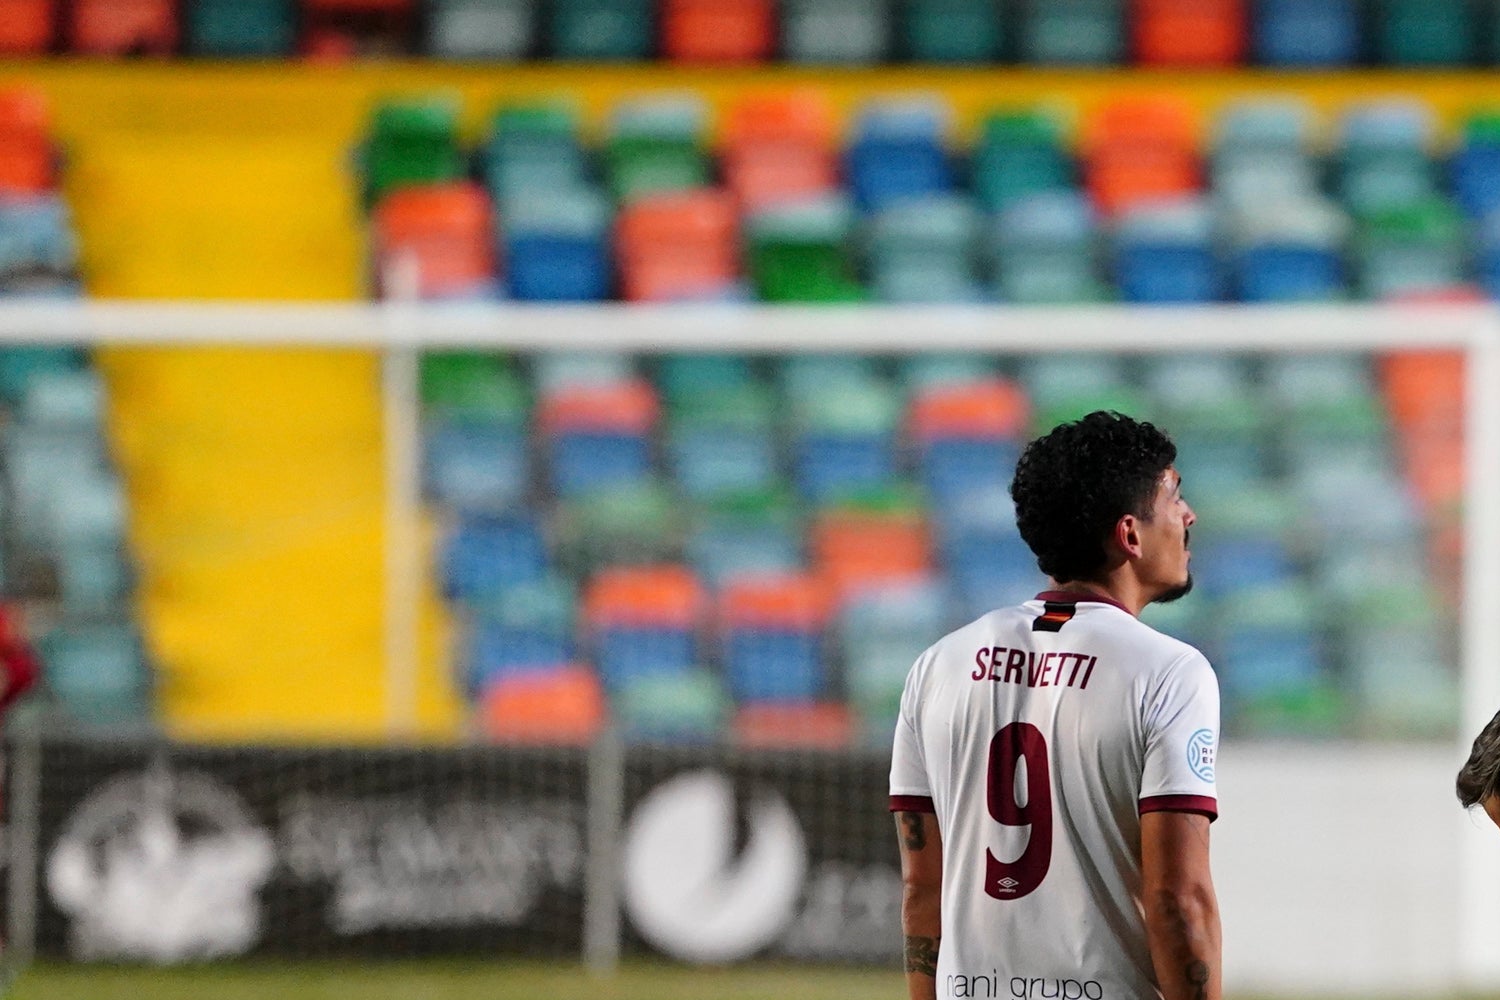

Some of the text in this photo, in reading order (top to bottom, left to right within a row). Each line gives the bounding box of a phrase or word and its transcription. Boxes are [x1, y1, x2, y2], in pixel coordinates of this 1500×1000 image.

[972, 646, 1097, 690] SERVETTI
[984, 721, 1053, 901] 9
[947, 968, 998, 998] nani
